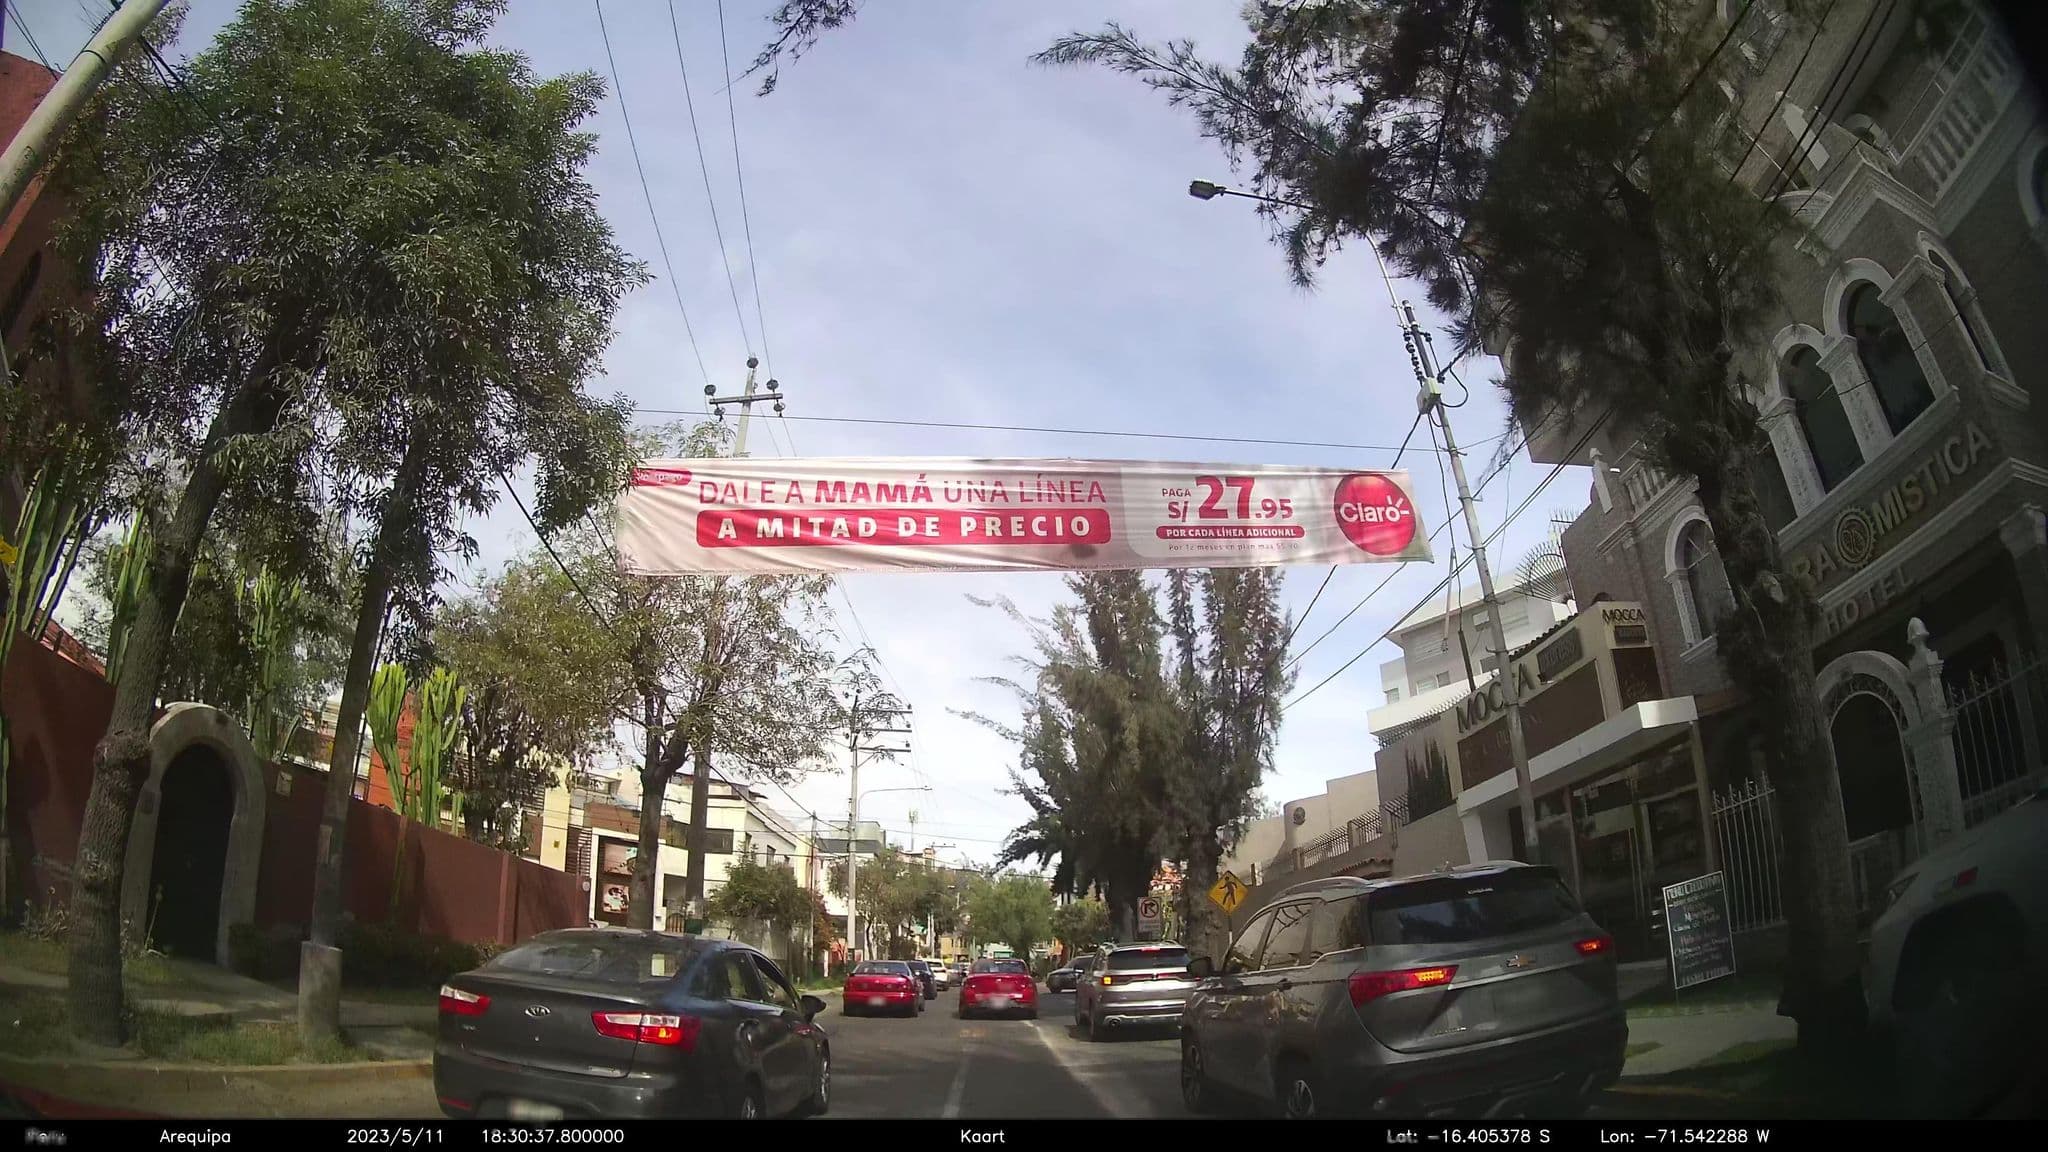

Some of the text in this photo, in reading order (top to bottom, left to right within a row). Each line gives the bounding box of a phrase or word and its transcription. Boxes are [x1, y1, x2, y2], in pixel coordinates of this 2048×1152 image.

[699, 473, 1107, 505] DALE A MAMÁ UNA LÍNEA
[1870, 421, 1994, 537] MISTICA
[1161, 488, 1192, 498] PAGA
[1338, 501, 1401, 524] Claro
[717, 514, 1092, 540] A MITAD DE PRECIO
[1166, 527, 1297, 538] POR CADA LÍNEA ADICIONAL
[1823, 565, 1918, 635] HOTEL
[1602, 608, 1647, 624] MOCCA
[1455, 662, 1537, 734] MOCA
